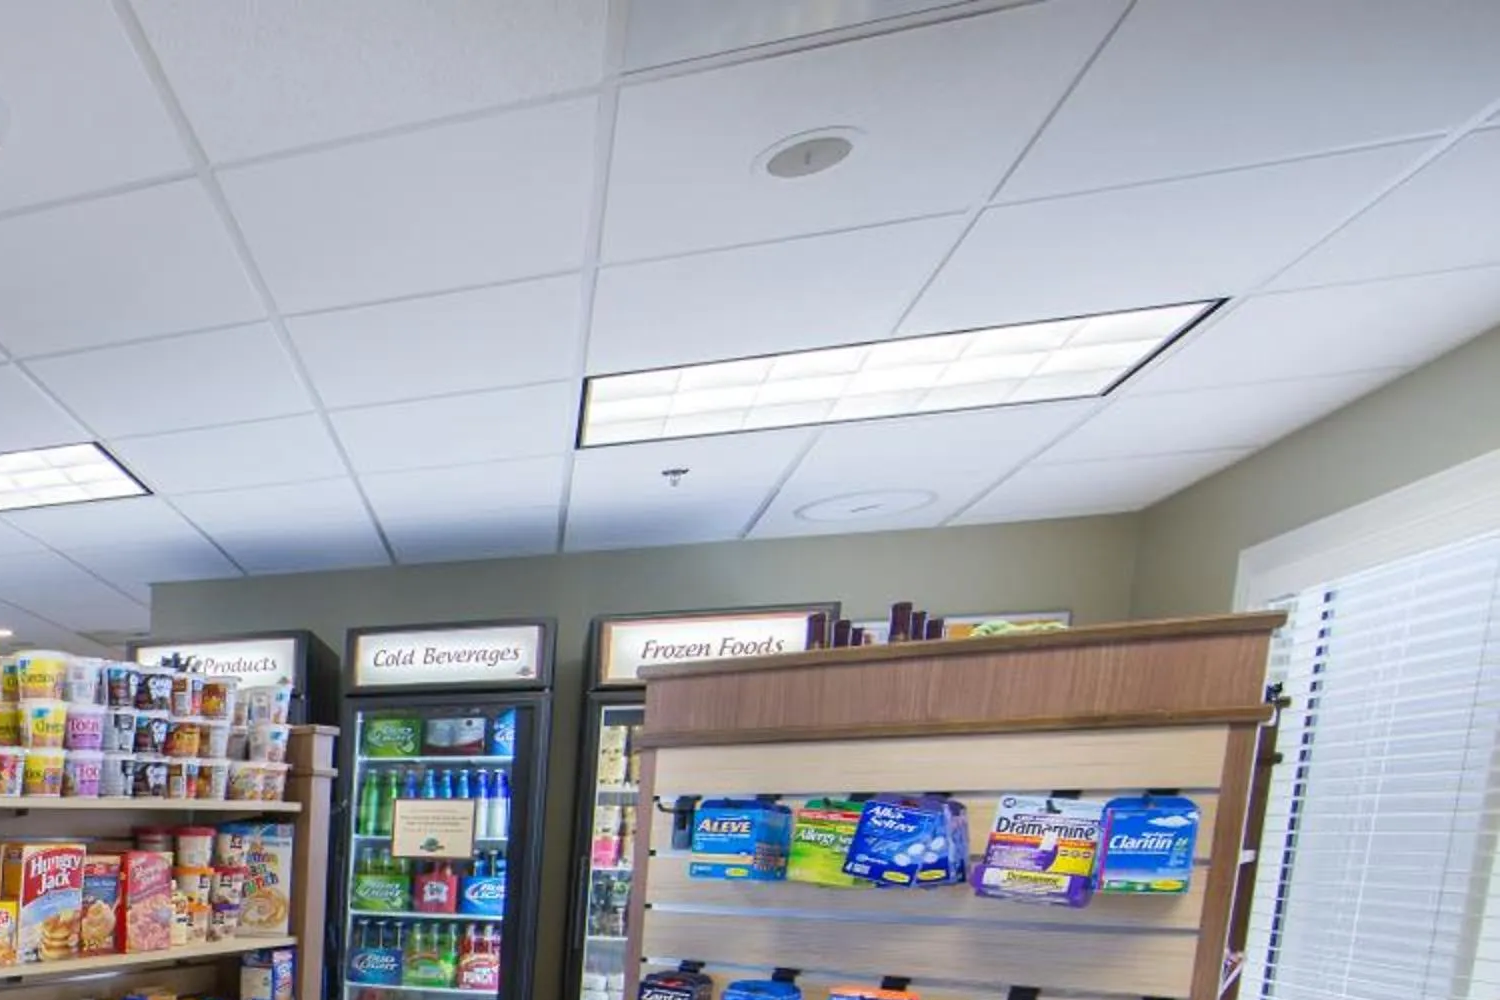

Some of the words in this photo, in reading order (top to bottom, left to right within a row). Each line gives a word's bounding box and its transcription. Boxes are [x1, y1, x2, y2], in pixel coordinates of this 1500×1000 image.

[373, 648, 415, 667] Cold
[423, 646, 520, 667] Beverages
[641, 639, 711, 660] Frozen
[719, 635, 785, 656] Foods
[203, 656, 278, 674] Products
[698, 818, 751, 833] ALEVE
[996, 815, 1097, 841] Dramamine
[1108, 833, 1173, 851] Claritin
[30, 853, 81, 878] Hungry
[37, 871, 71, 895] Jack
